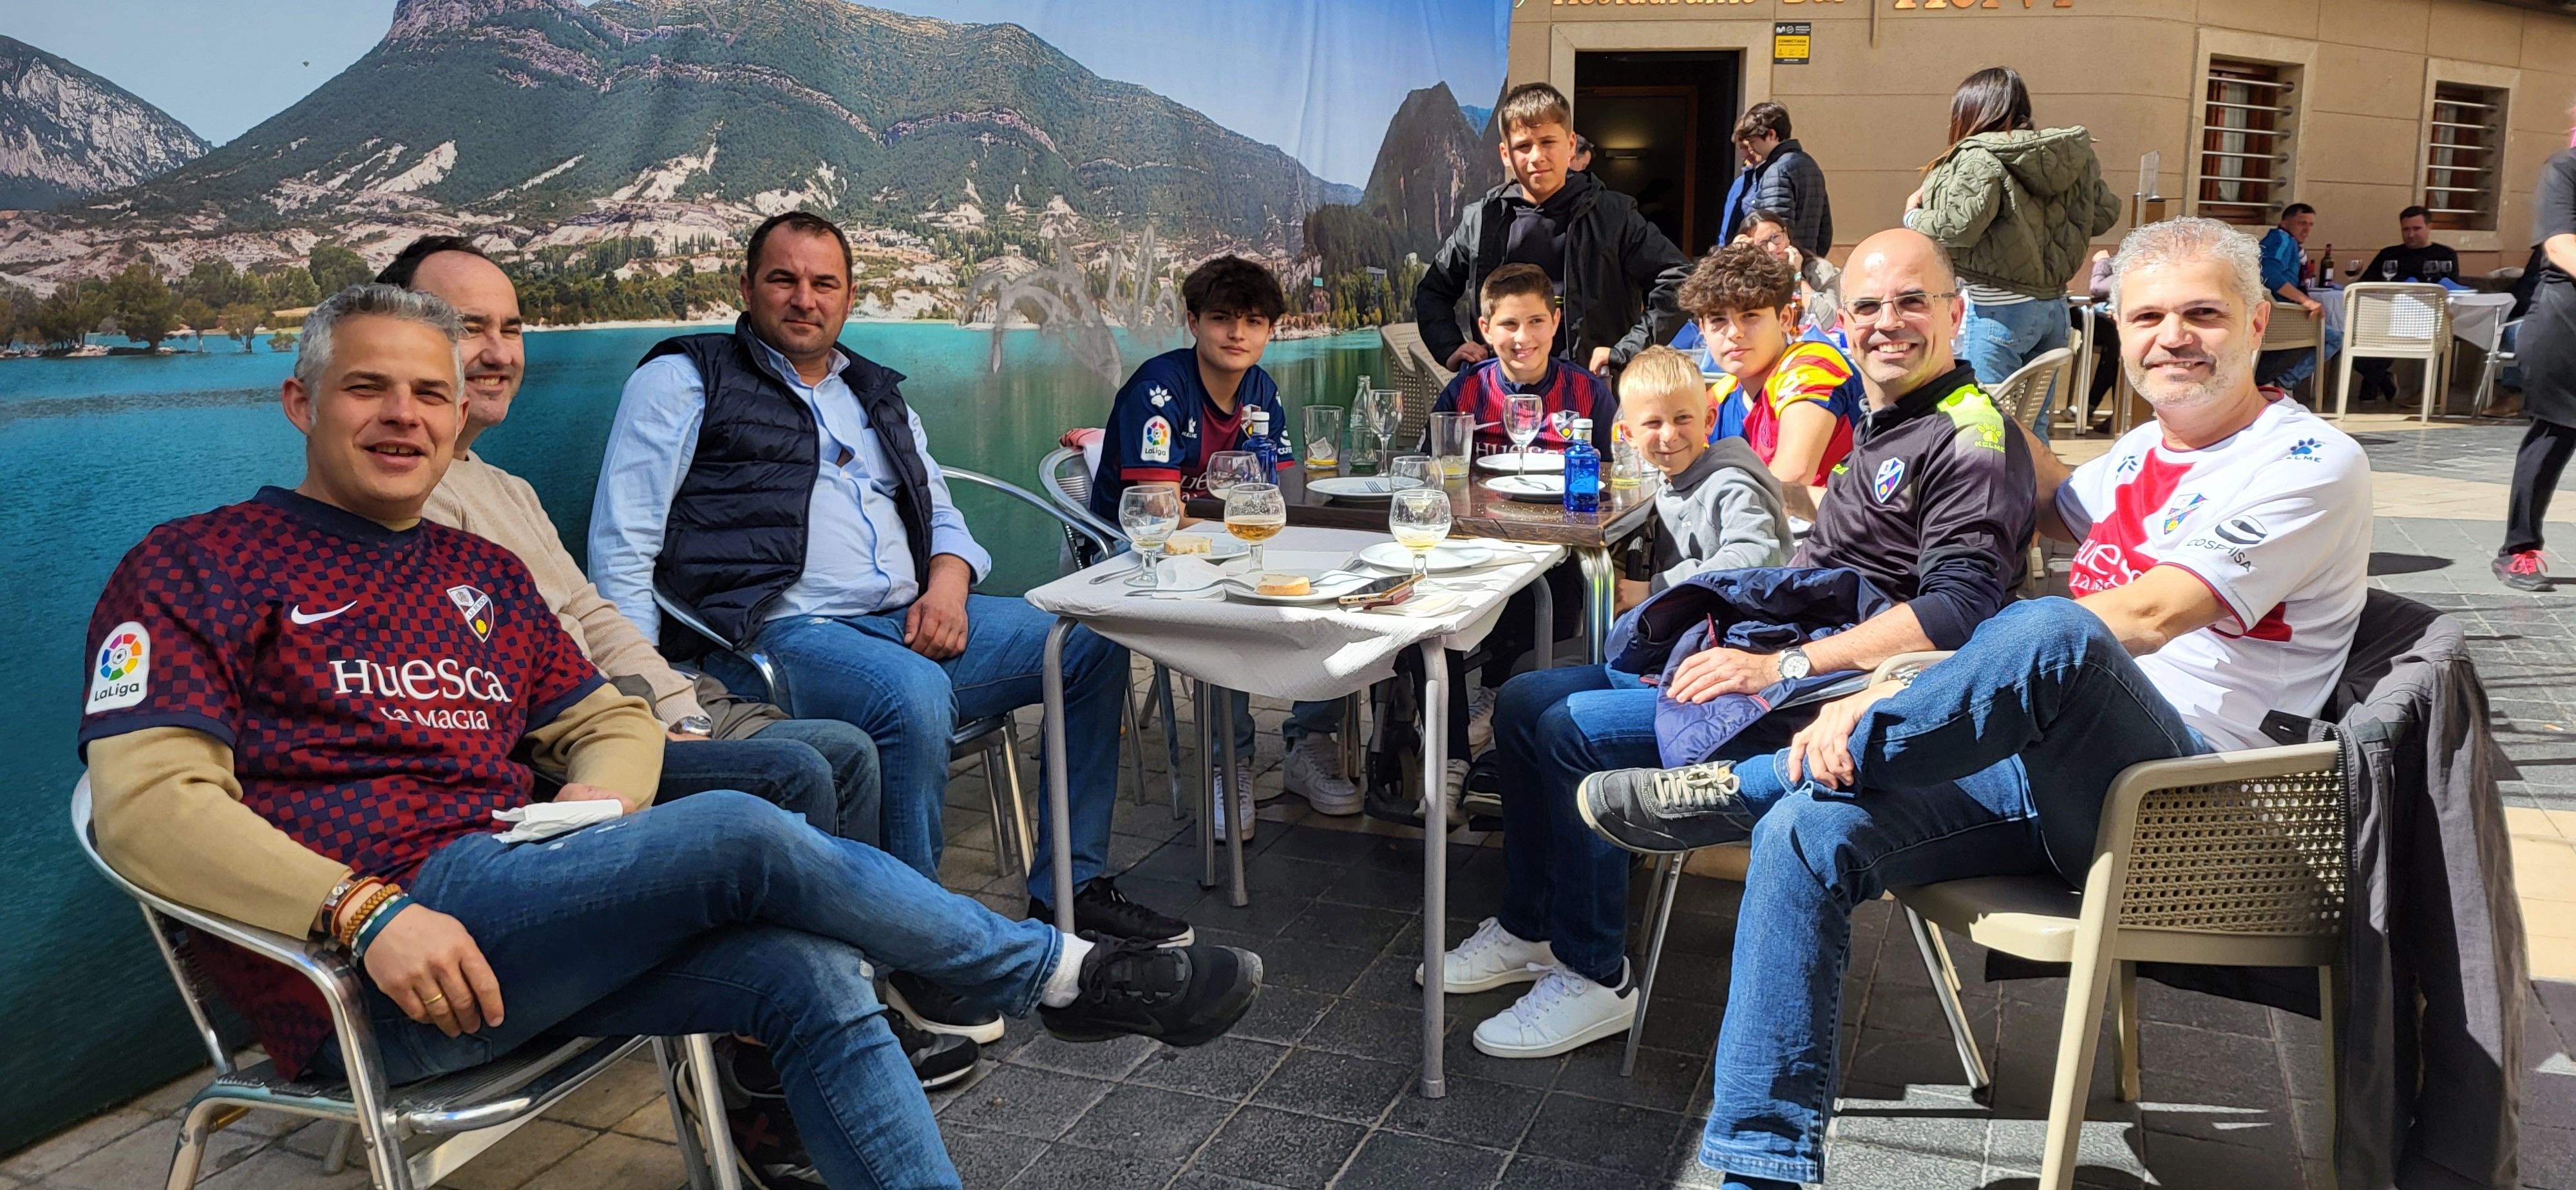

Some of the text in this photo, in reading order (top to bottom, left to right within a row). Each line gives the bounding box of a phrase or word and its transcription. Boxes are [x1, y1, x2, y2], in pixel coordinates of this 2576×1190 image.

[1144, 448, 1166, 456] LaLiga
[1974, 440, 2005, 453] KELME
[329, 658, 513, 703] Huesca
[94, 683, 140, 702] LaLiga
